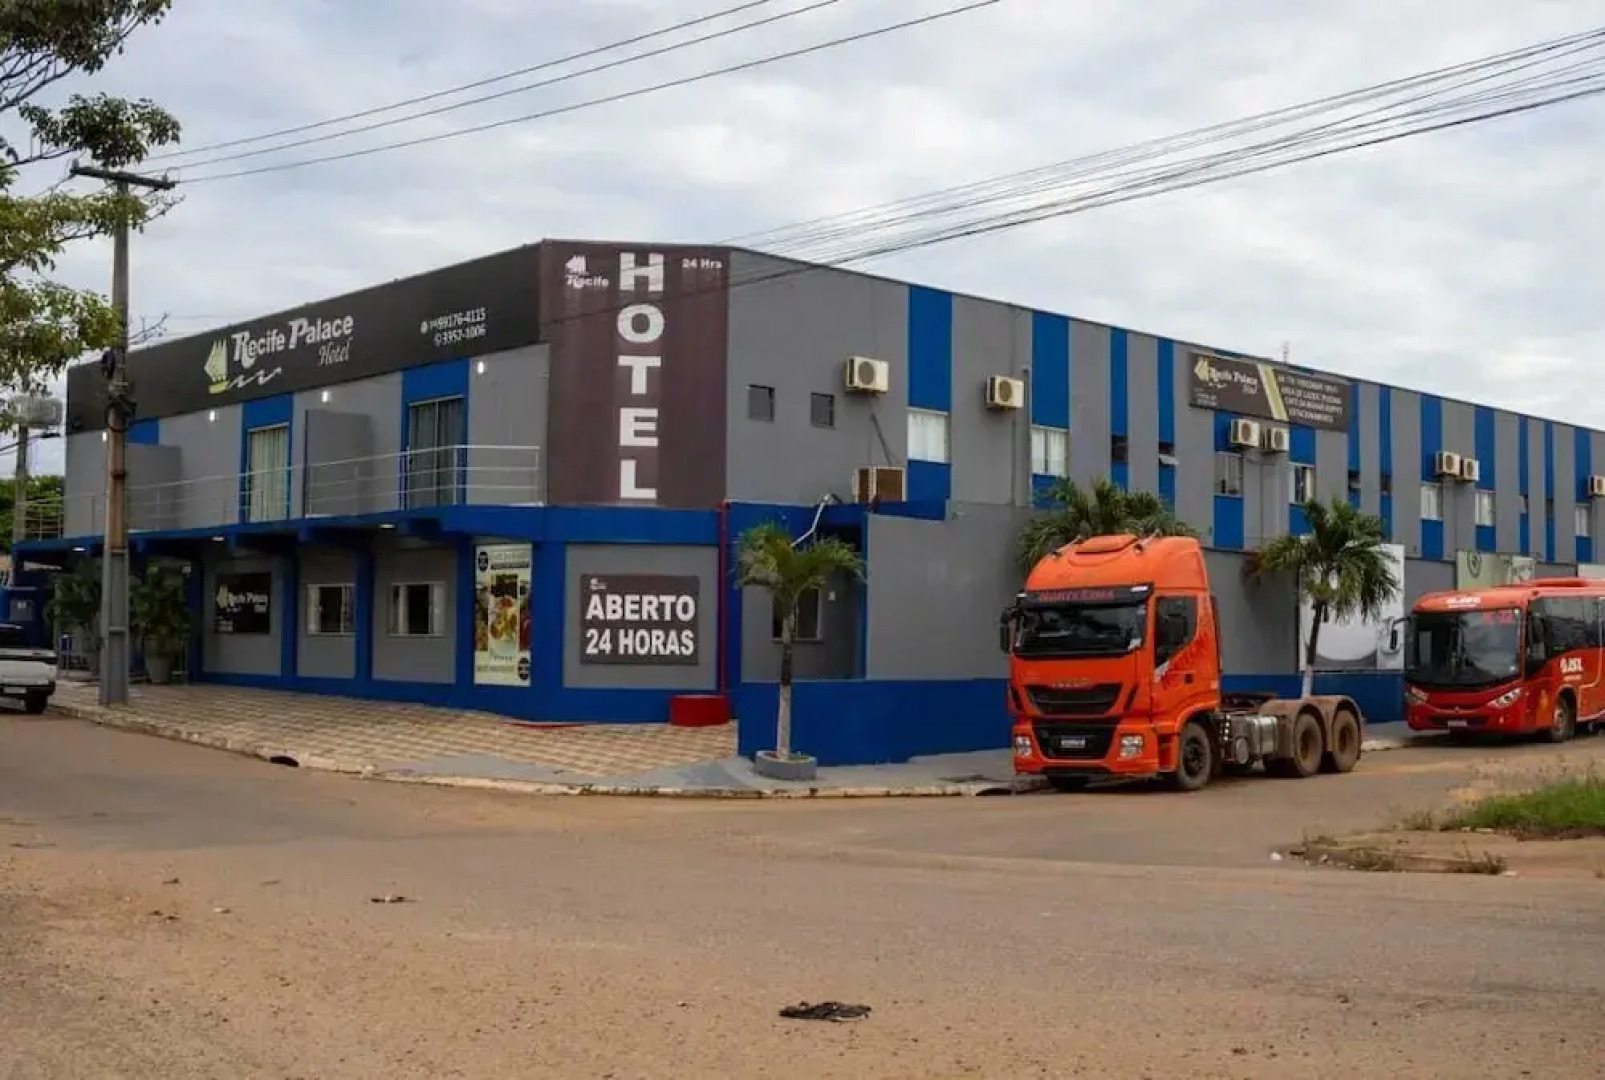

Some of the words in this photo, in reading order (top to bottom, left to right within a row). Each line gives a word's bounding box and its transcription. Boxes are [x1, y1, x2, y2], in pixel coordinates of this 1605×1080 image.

[682, 258, 697, 269] 24
[701, 258, 722, 269] Hrs
[566, 274, 610, 289] Recife
[231, 329, 285, 369] Recife
[289, 315, 354, 349] Palace
[617, 252, 665, 499] HOTEL
[585, 594, 696, 621] ABERTO
[585, 628, 611, 655] 24
[618, 628, 695, 656] HORAS
